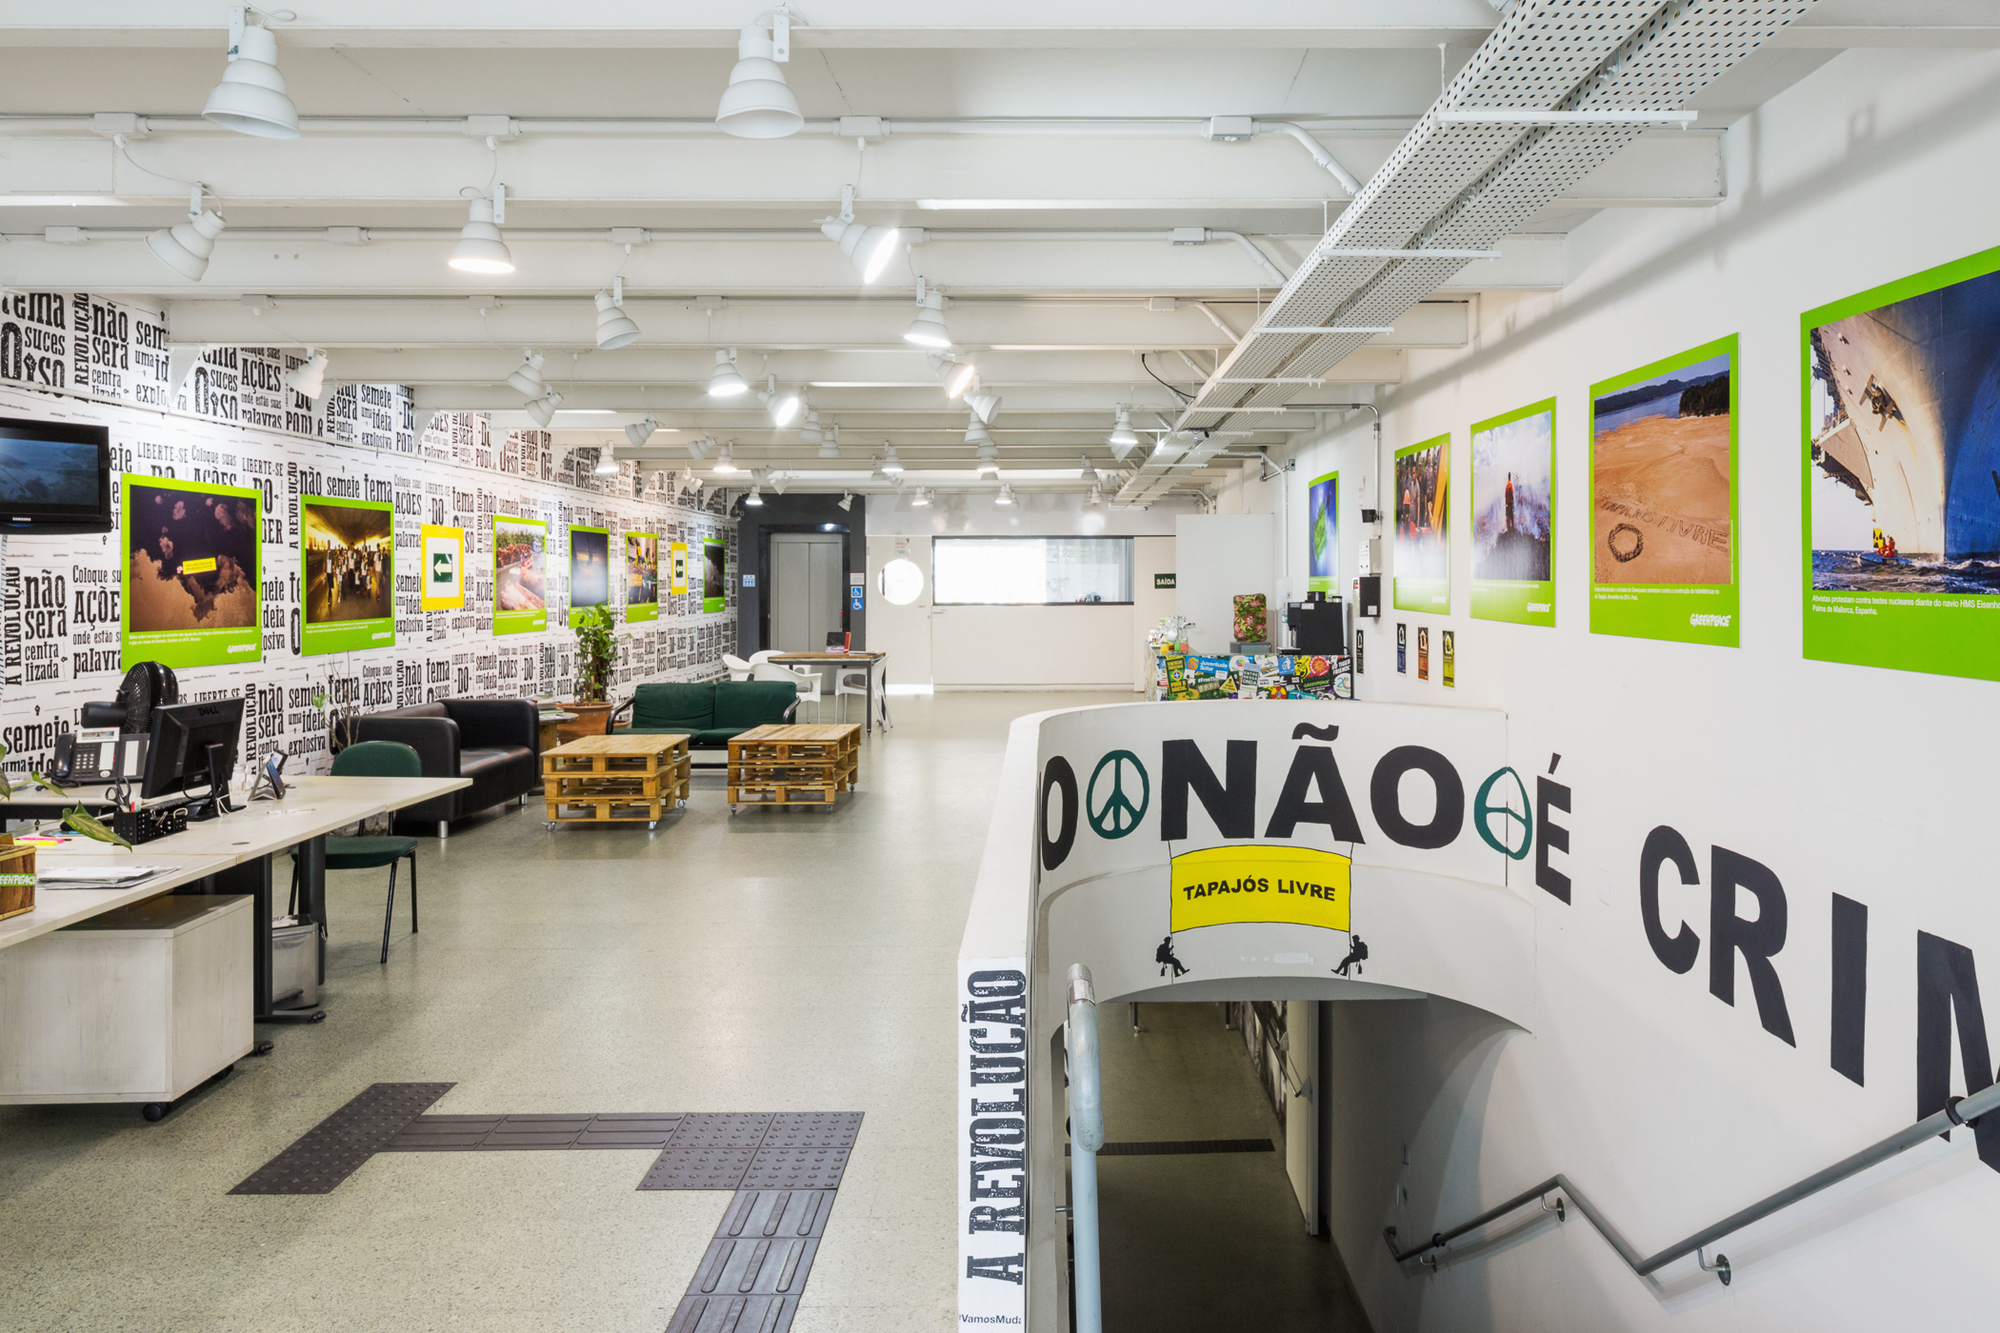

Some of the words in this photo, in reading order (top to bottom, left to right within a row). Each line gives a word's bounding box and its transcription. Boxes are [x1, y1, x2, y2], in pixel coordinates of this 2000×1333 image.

[91, 302, 129, 343] não
[25, 326, 65, 356] suces
[92, 337, 129, 371] será
[135, 351, 154, 368] uma
[92, 369, 122, 388] centra
[209, 369, 238, 393] suces
[241, 357, 281, 394] AÇÕES
[336, 396, 358, 421] será
[361, 384, 392, 409] semeie
[372, 408, 392, 433] ideia
[137, 441, 189, 463] LIBERTE-SE
[191, 444, 219, 466] Coloque
[221, 453, 237, 467] suas
[242, 457, 284, 477] LIBERTE-SE
[300, 465, 323, 496] não
[326, 476, 360, 499] semeie
[363, 473, 393, 504] tema
[287, 461, 299, 537] REVOLUÇÃO
[394, 489, 422, 518] AÇÕES
[452, 486, 475, 514] tema
[1657, 515, 1728, 553] LIVRE
[73, 565, 108, 586] Coloque
[112, 569, 121, 583] su
[1156, 577, 1175, 586] SAÍDA
[24, 568, 66, 610] não
[73, 586, 121, 631] AÇÕE
[1812, 604, 1826, 612] Palma
[1833, 605, 1854, 614] Mallorca,
[1831, 596, 1854, 604] protestam
[1872, 597, 1887, 605] testes
[1889, 597, 1914, 606] nucleares
[1915, 598, 1932, 606] diante
[1933, 598, 1941, 607] do
[1943, 599, 1959, 608] navio
[1960, 599, 1975, 608] HMS
[25, 605, 67, 640] será
[262, 604, 285, 628] deia
[1690, 613, 1731, 627] GREENPEACE
[25, 640, 59, 660] centra
[73, 631, 91, 645] onde
[94, 630, 113, 644] estão
[25, 659, 59, 682] lizada
[426, 657, 450, 684] tema
[1200, 661, 1228, 669] Juventude
[258, 682, 284, 715] não
[363, 677, 393, 711] AÇÕES
[198, 705, 219, 716] DELL
[245, 682, 258, 762] REVOLUÇÃO
[288, 712, 302, 725] uma
[258, 710, 284, 740] será
[288, 734, 326, 758] explosiva
[1161, 722, 1465, 850] NÃO
[1535, 752, 1571, 906] É
[1183, 875, 1269, 901] TAPAJÓS
[1277, 879, 1336, 902] LIVRE
[967, 1253, 1024, 1285] A
